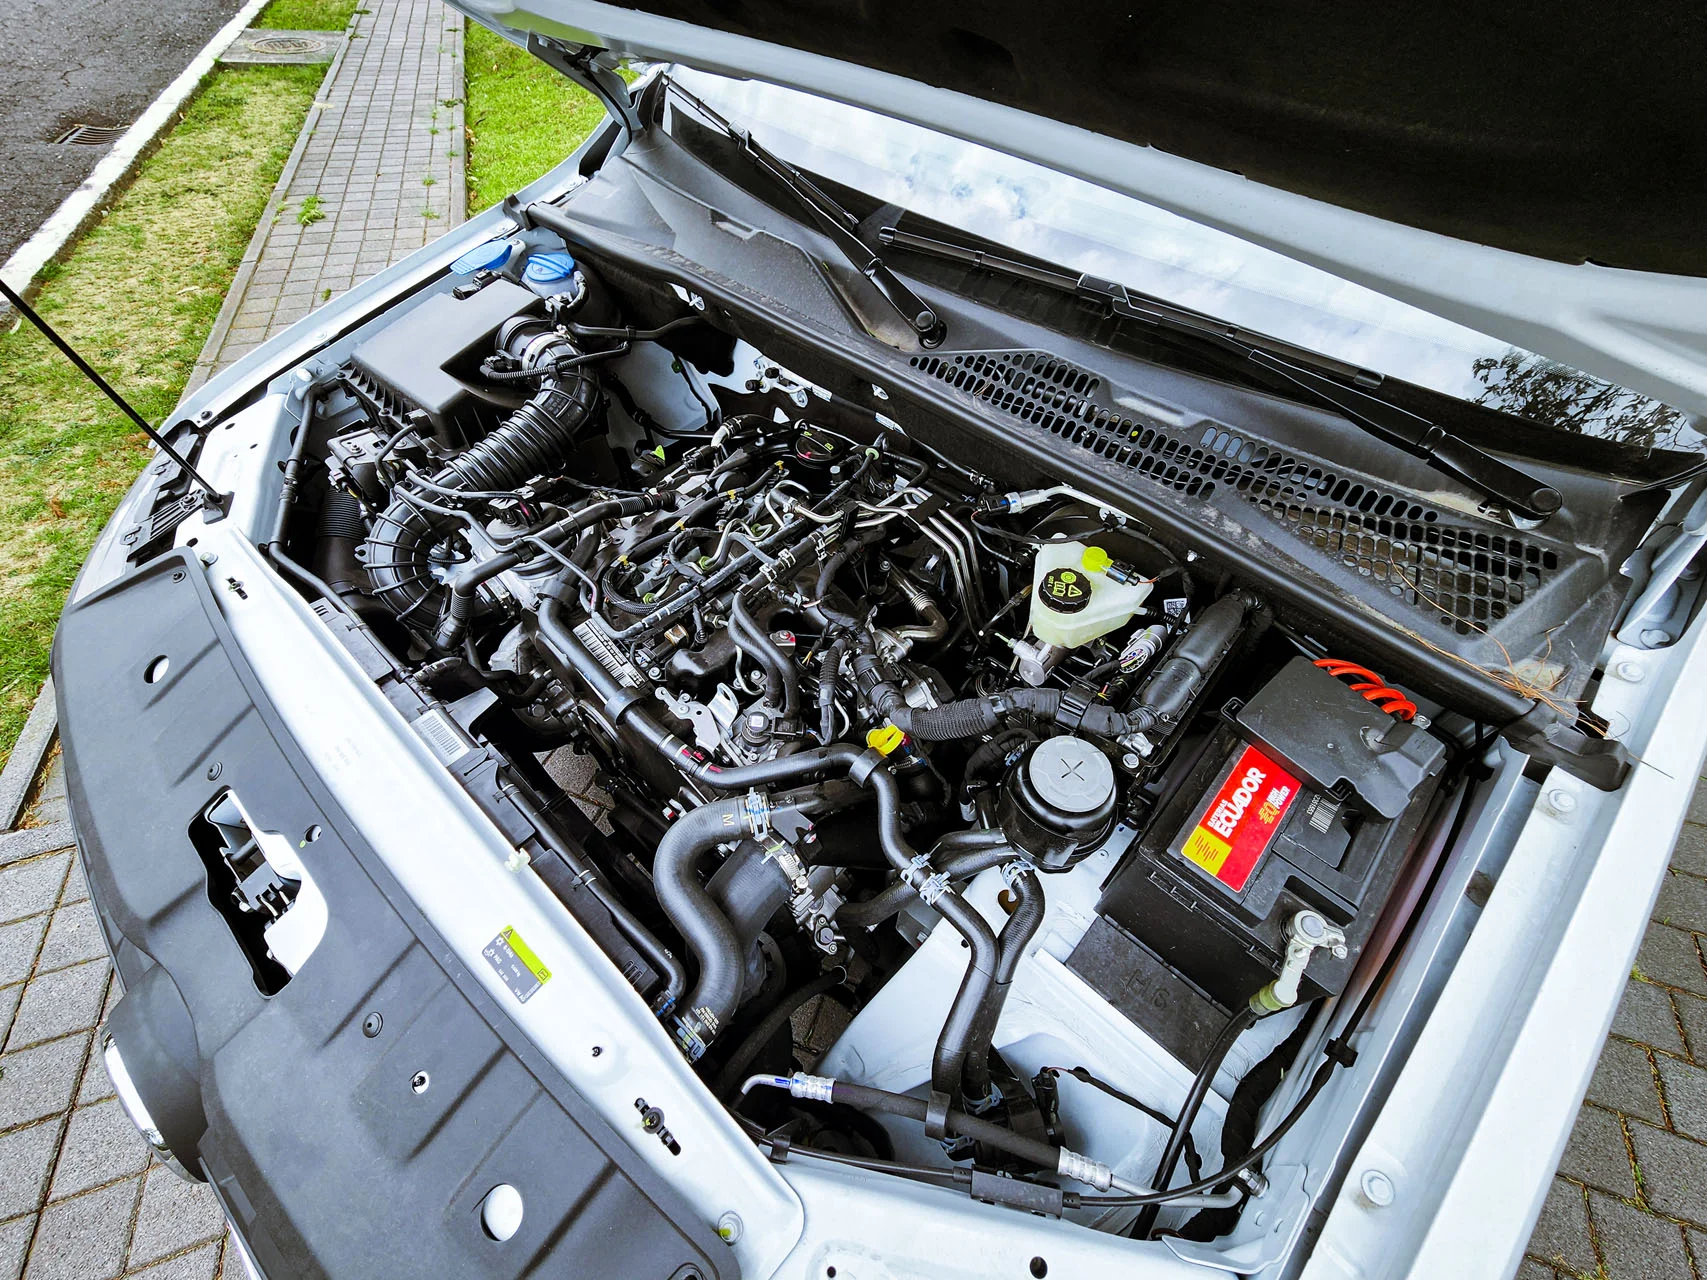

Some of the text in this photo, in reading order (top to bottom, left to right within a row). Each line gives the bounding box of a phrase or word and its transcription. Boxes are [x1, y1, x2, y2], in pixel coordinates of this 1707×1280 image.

[1212, 767, 1266, 838] ECUADOR
[1265, 787, 1280, 803] HIGH
[1272, 785, 1290, 809] POWER
[722, 813, 735, 826] M
[1207, 799, 1228, 827] BATERIAS
